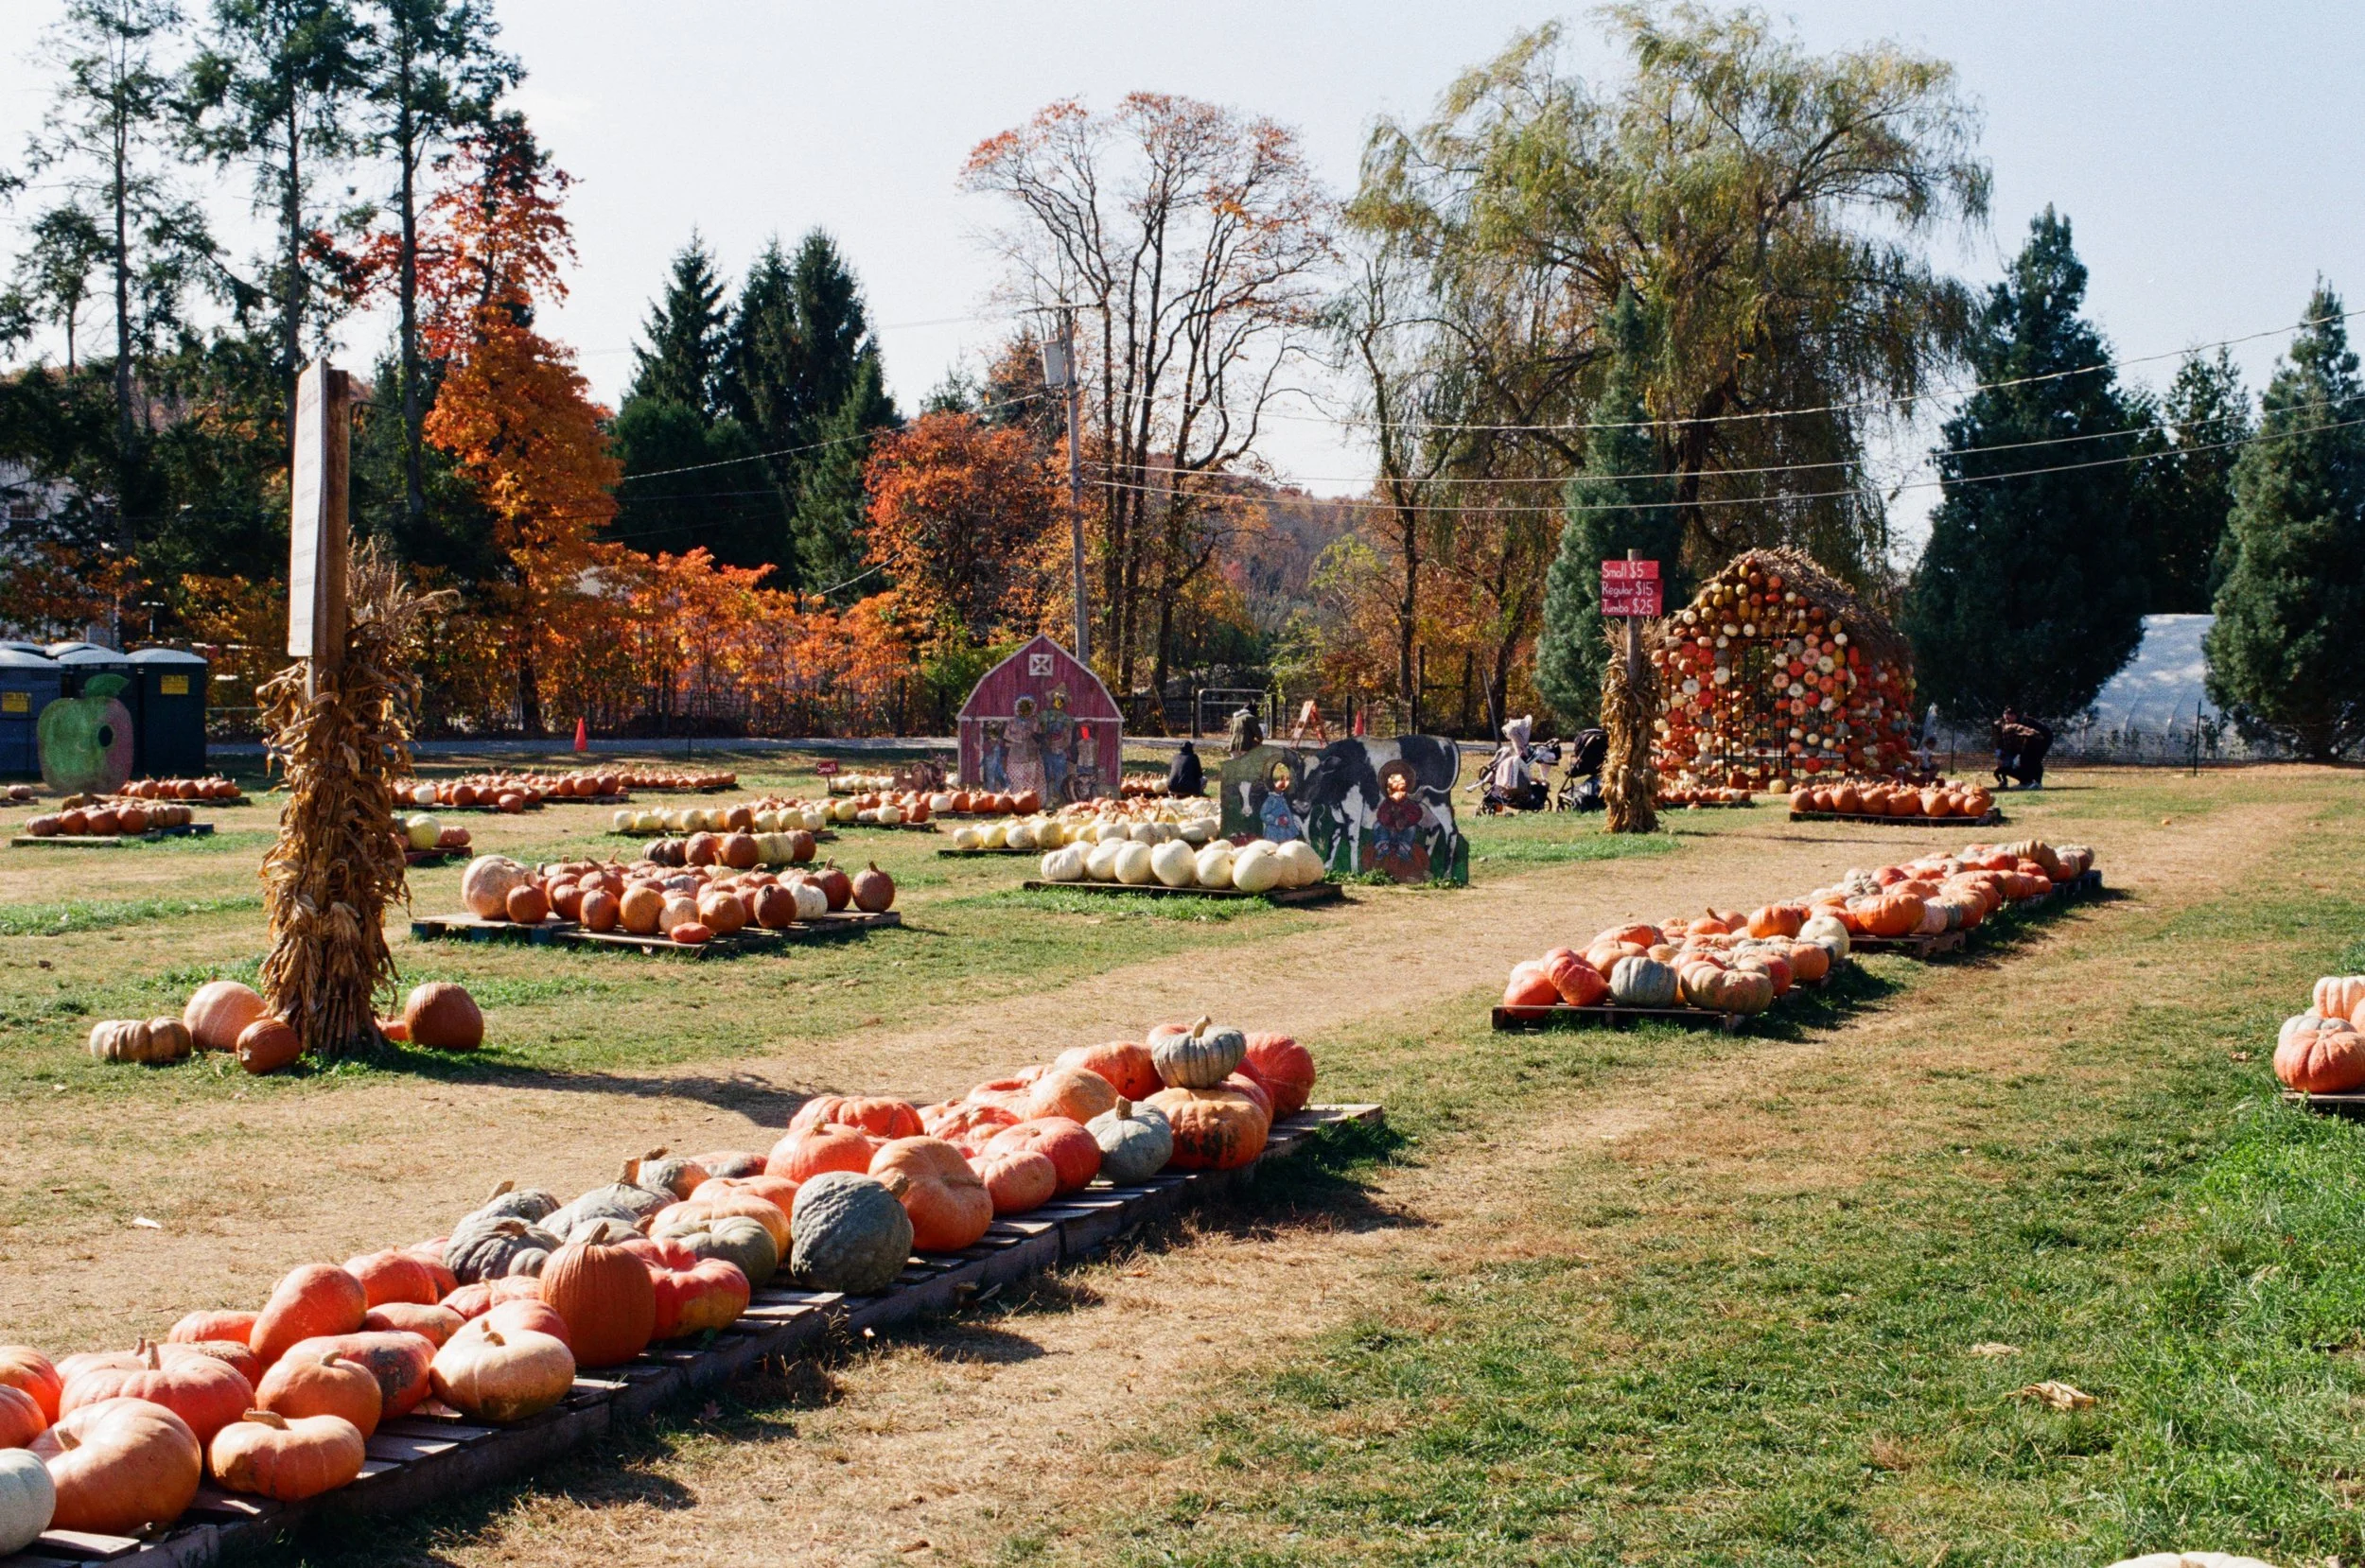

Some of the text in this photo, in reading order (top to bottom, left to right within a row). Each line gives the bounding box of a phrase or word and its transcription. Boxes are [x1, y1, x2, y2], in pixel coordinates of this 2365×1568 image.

[1602, 562, 1644, 579] Small $5
[1602, 581, 1654, 598] Regular $15
[1602, 598, 1654, 614] Jumbo $25
[817, 763, 835, 774] Small
